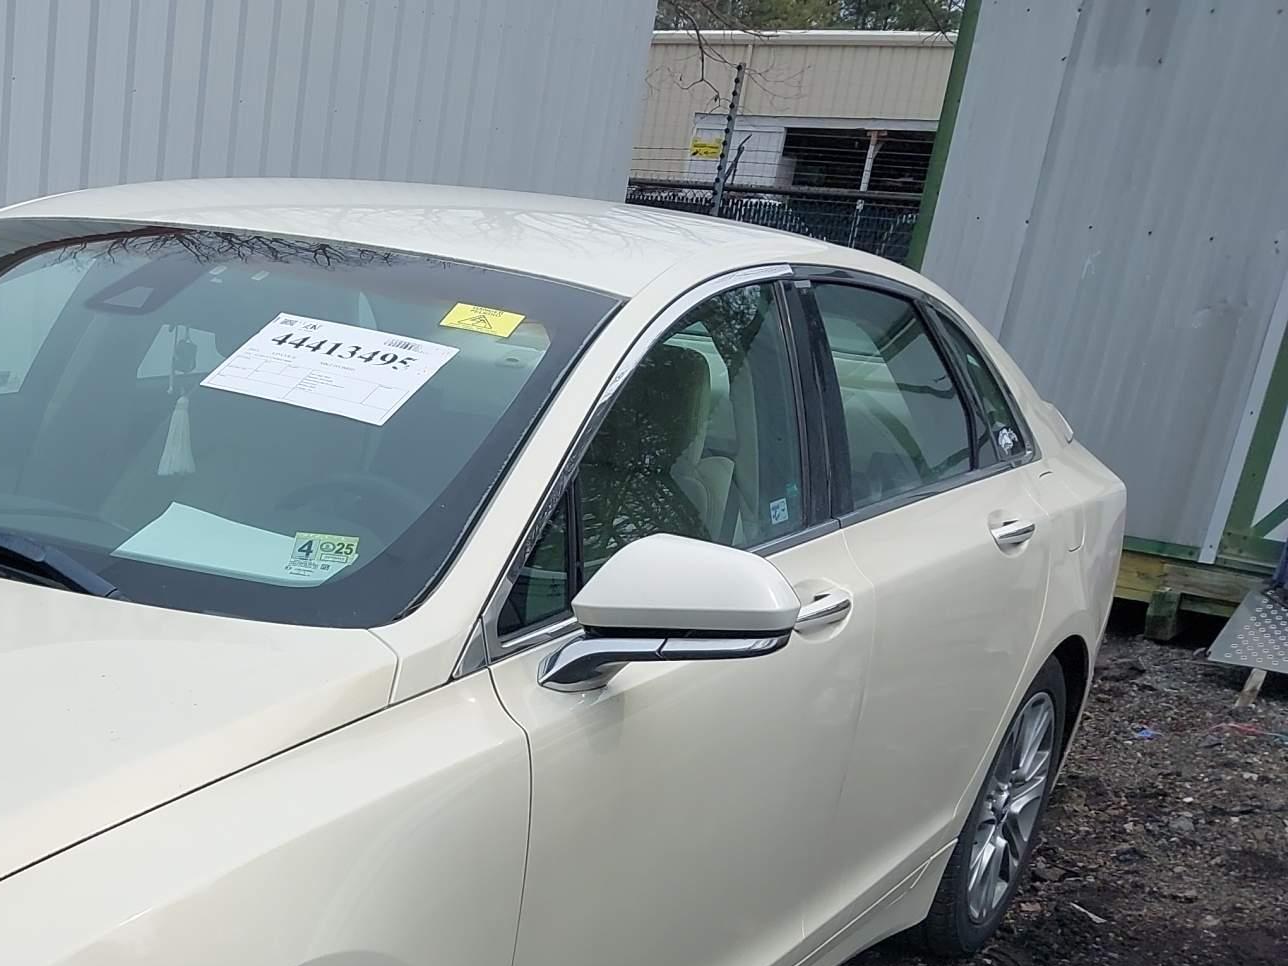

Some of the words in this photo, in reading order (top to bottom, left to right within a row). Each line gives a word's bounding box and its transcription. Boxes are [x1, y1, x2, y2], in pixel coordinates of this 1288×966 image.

[271, 332, 418, 371] 44413495
[297, 539, 313, 558] 4
[334, 542, 355, 556] 25
